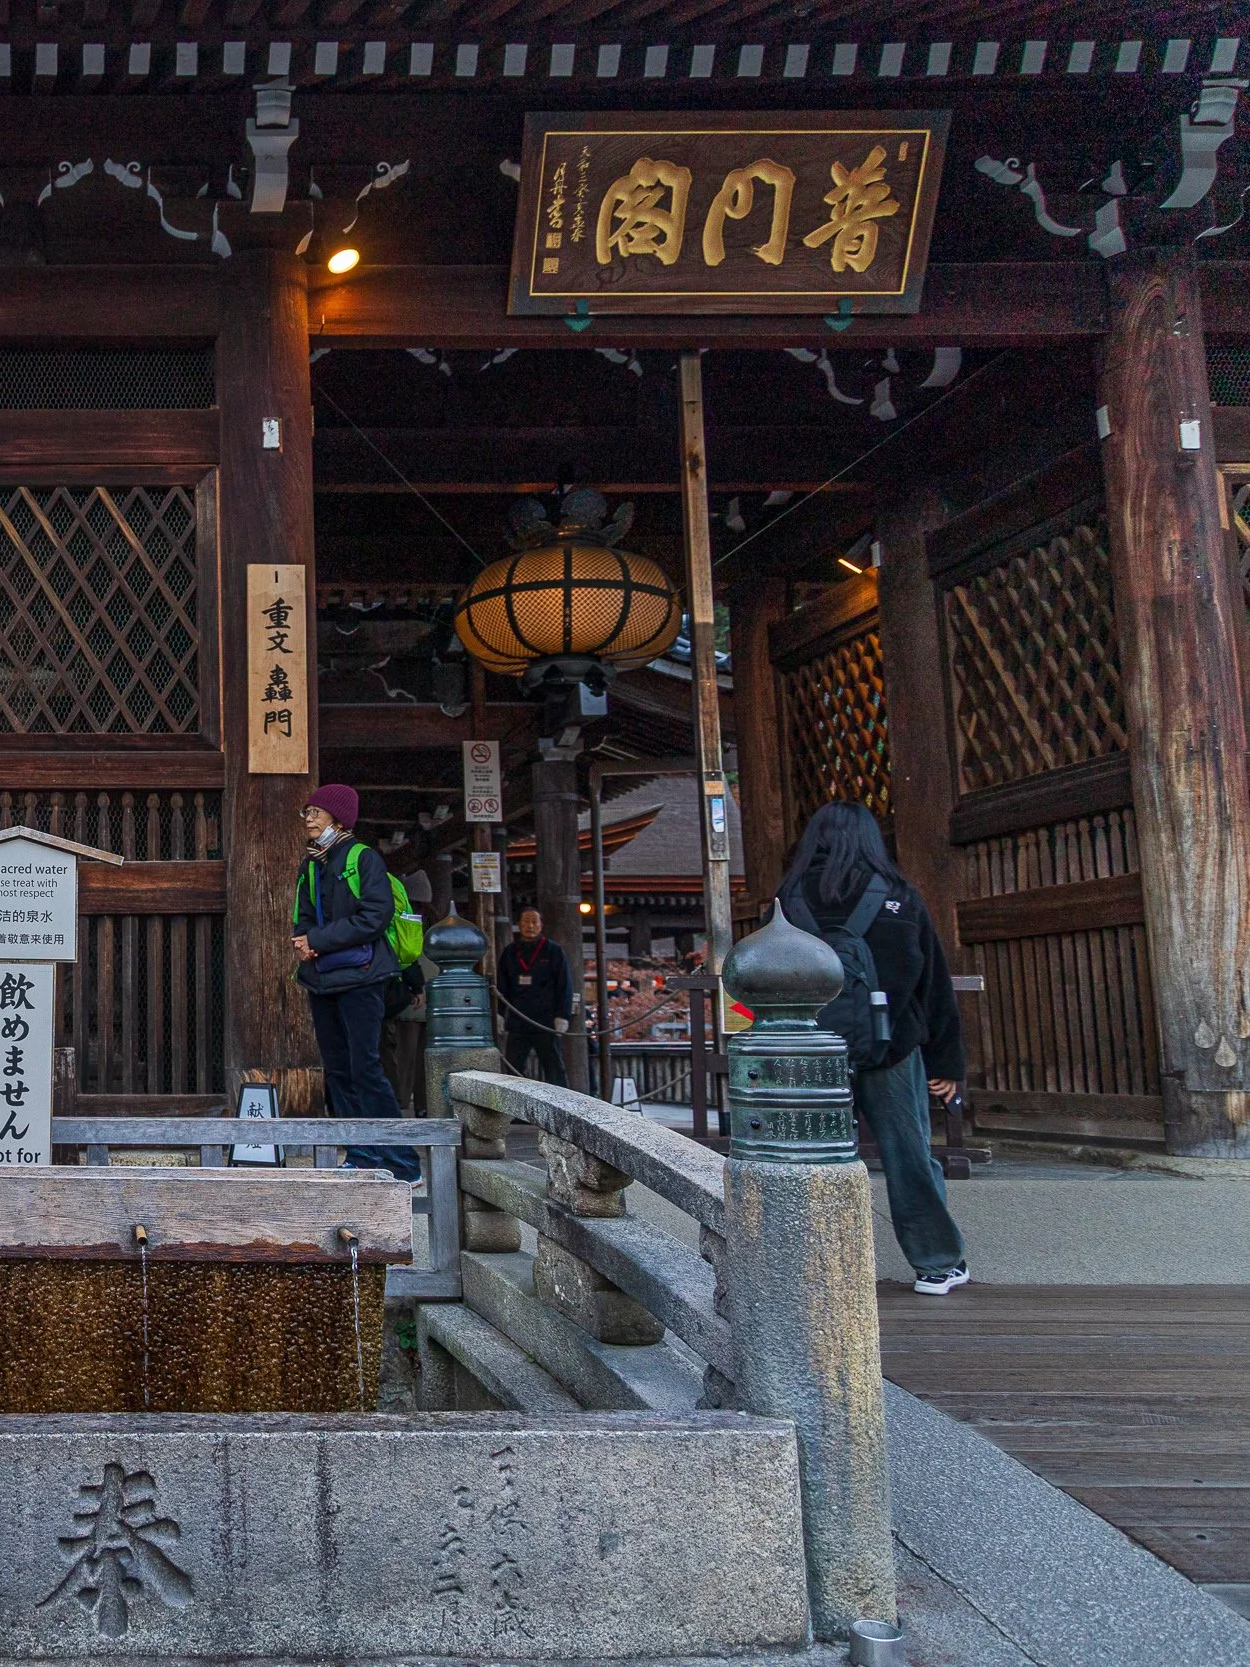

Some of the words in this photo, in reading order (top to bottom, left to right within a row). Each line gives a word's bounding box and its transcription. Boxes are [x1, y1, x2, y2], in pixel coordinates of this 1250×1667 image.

[35, 865, 68, 875] water
[13, 879, 35, 888] treat
[37, 879, 58, 888] with
[20, 889, 54, 899] respect
[17, 1148, 41, 1163] for
